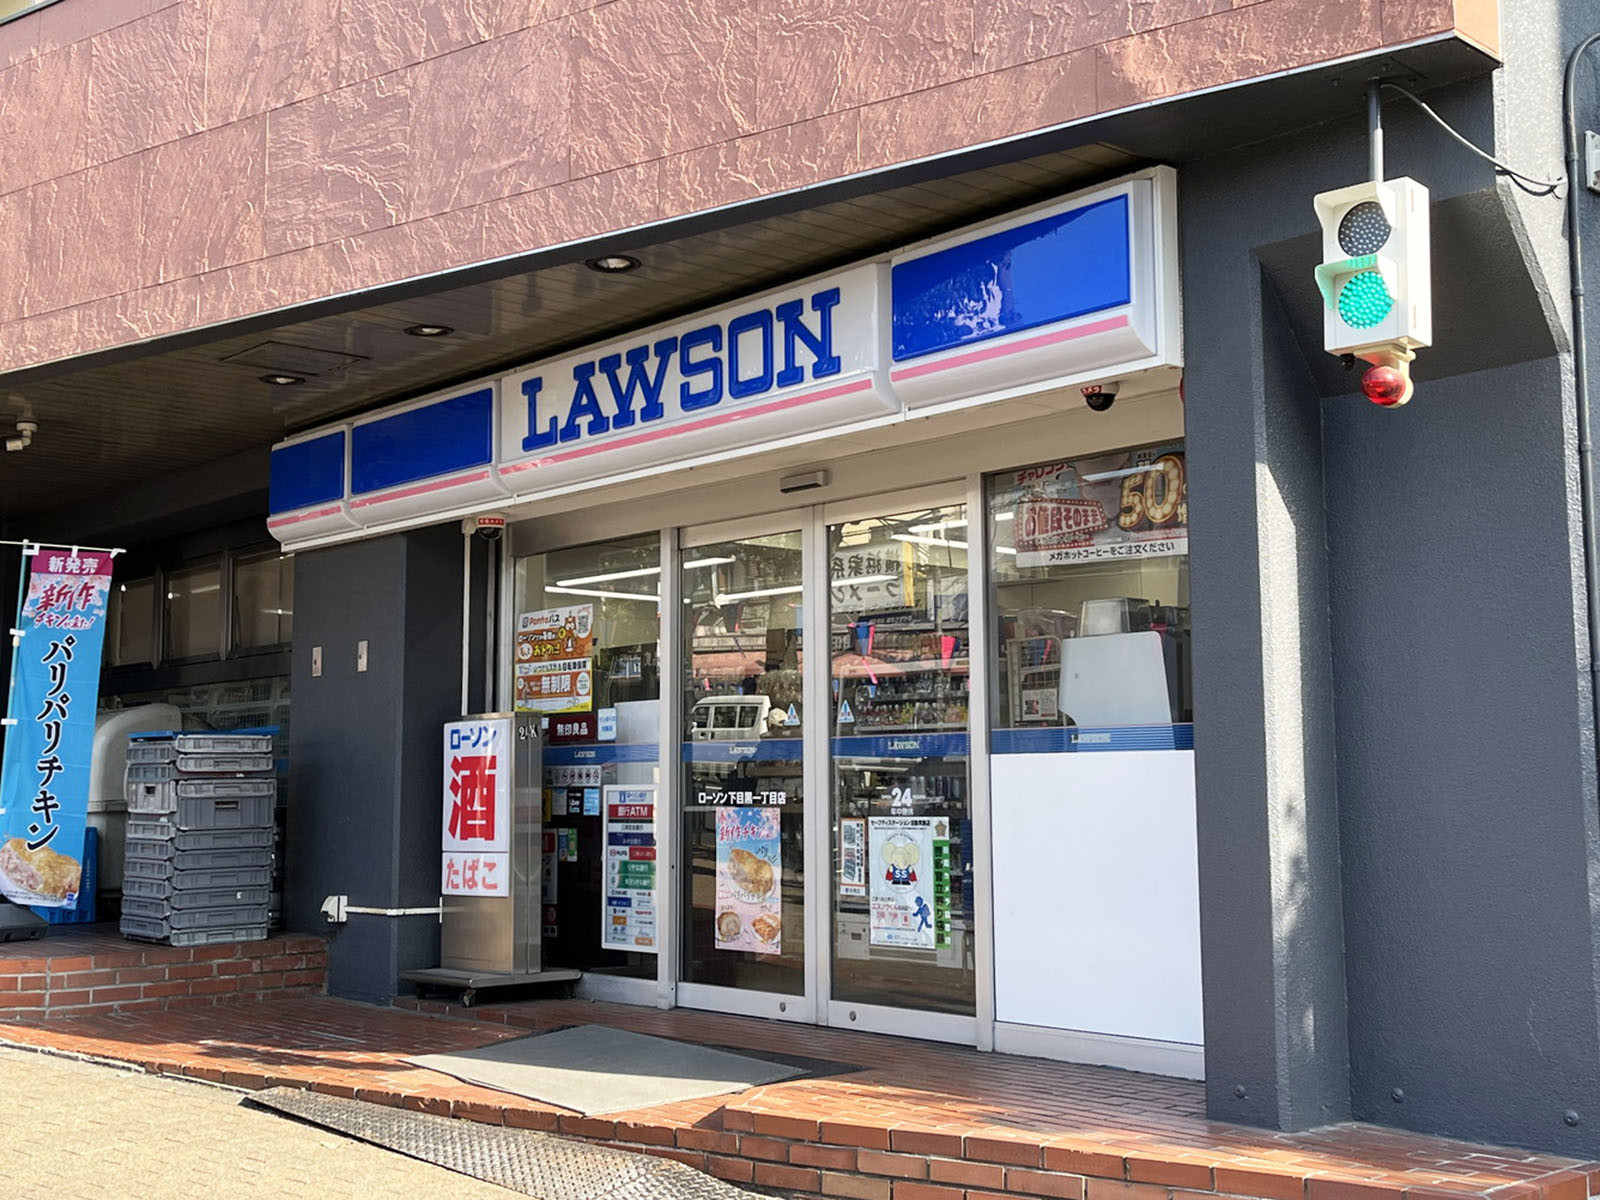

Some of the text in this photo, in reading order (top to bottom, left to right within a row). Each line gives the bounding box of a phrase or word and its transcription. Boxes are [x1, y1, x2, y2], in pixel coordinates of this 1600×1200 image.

[522, 287, 841, 452] LAWSON
[1025, 506, 1100, 537] お値段そのまま
[1049, 542, 1175, 561] メガホットコーヒーをご注文ください
[48, 556, 99, 574] 新発売
[36, 582, 95, 611] 新作
[541, 674, 571, 693] 無制限
[450, 726, 496, 749] ローソン
[556, 722, 588, 736] 無印良品
[26, 635, 76, 852] パリパリチキン
[448, 755, 497, 840] 酒
[698, 792, 786, 804] ローソン下目黒一丁目店
[891, 787, 913, 807] 24
[618, 806, 648, 816] 銀行ATM
[446, 858, 498, 889] たばこ
[894, 870, 908, 878] SS
